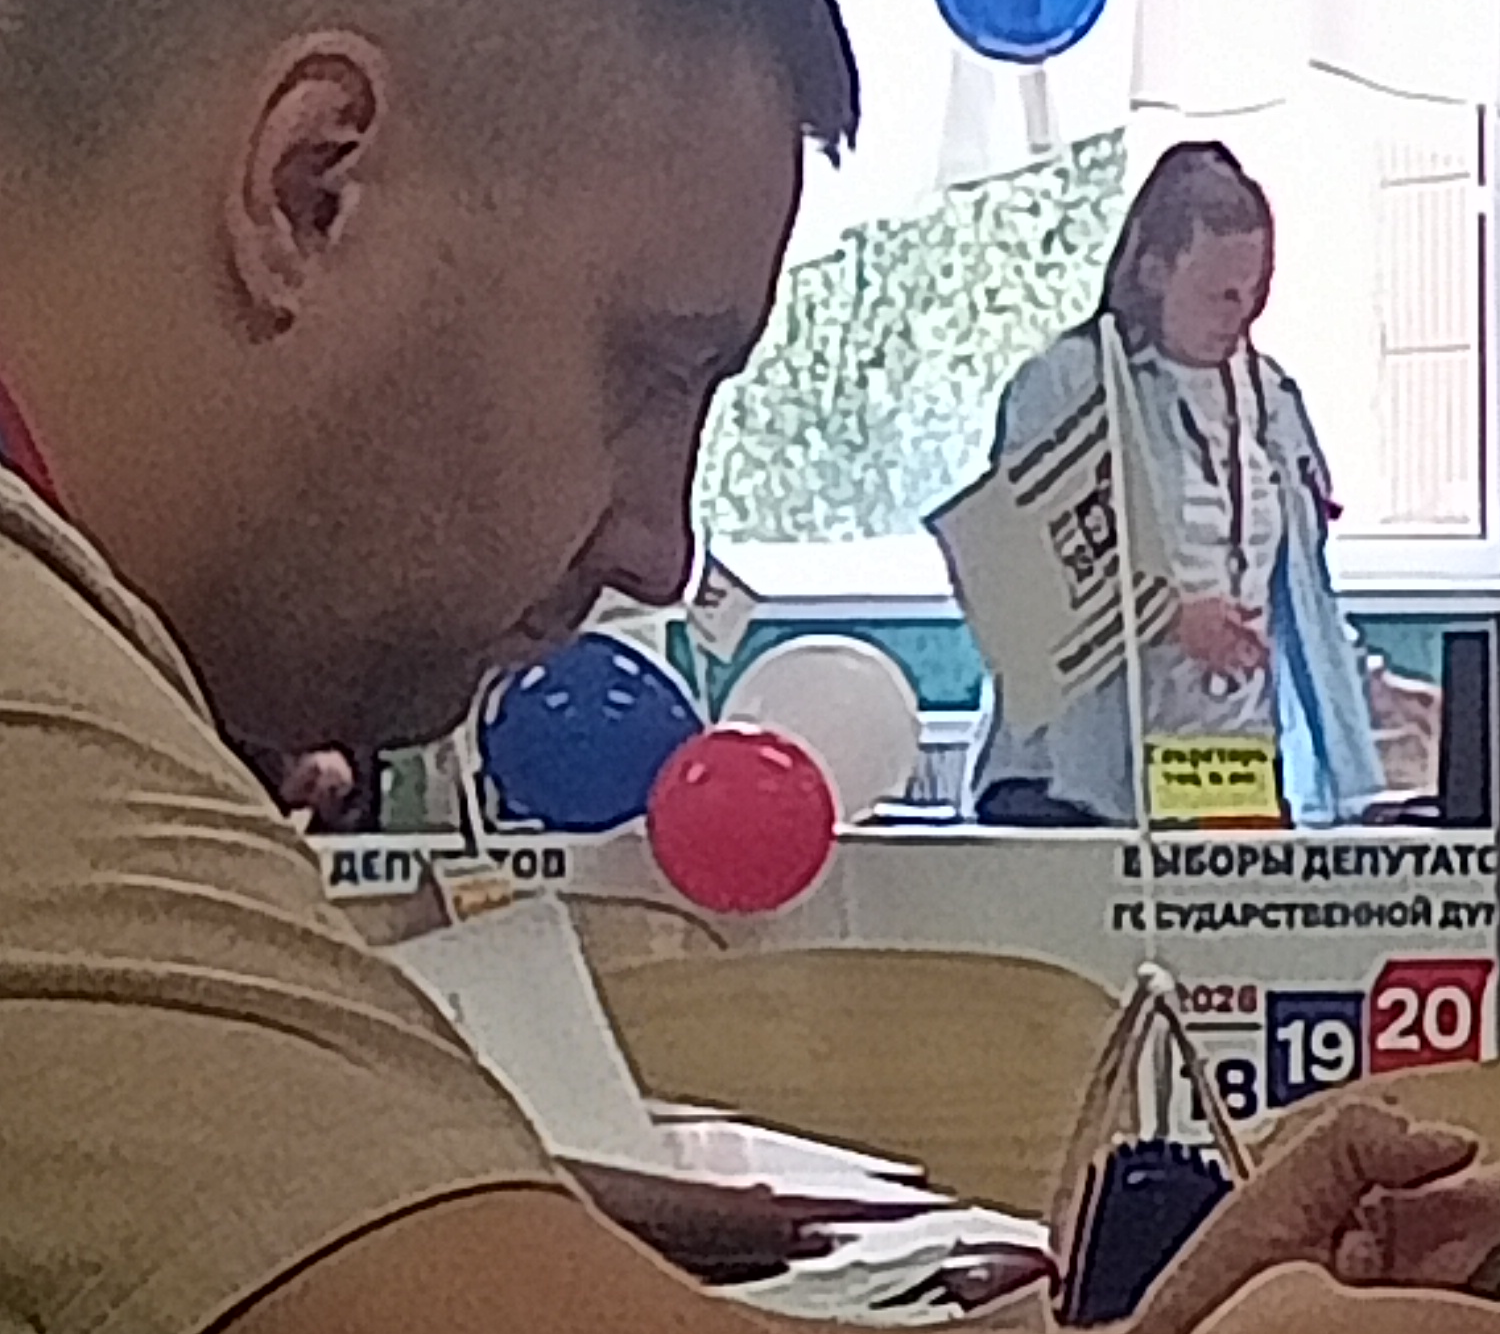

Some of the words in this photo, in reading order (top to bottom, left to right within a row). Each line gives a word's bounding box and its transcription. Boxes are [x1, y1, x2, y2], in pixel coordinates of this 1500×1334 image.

[1123, 843, 1294, 878] ВЫБОРЫ
[1276, 1018, 1356, 1085] 19
[1375, 985, 1473, 1051] 20
